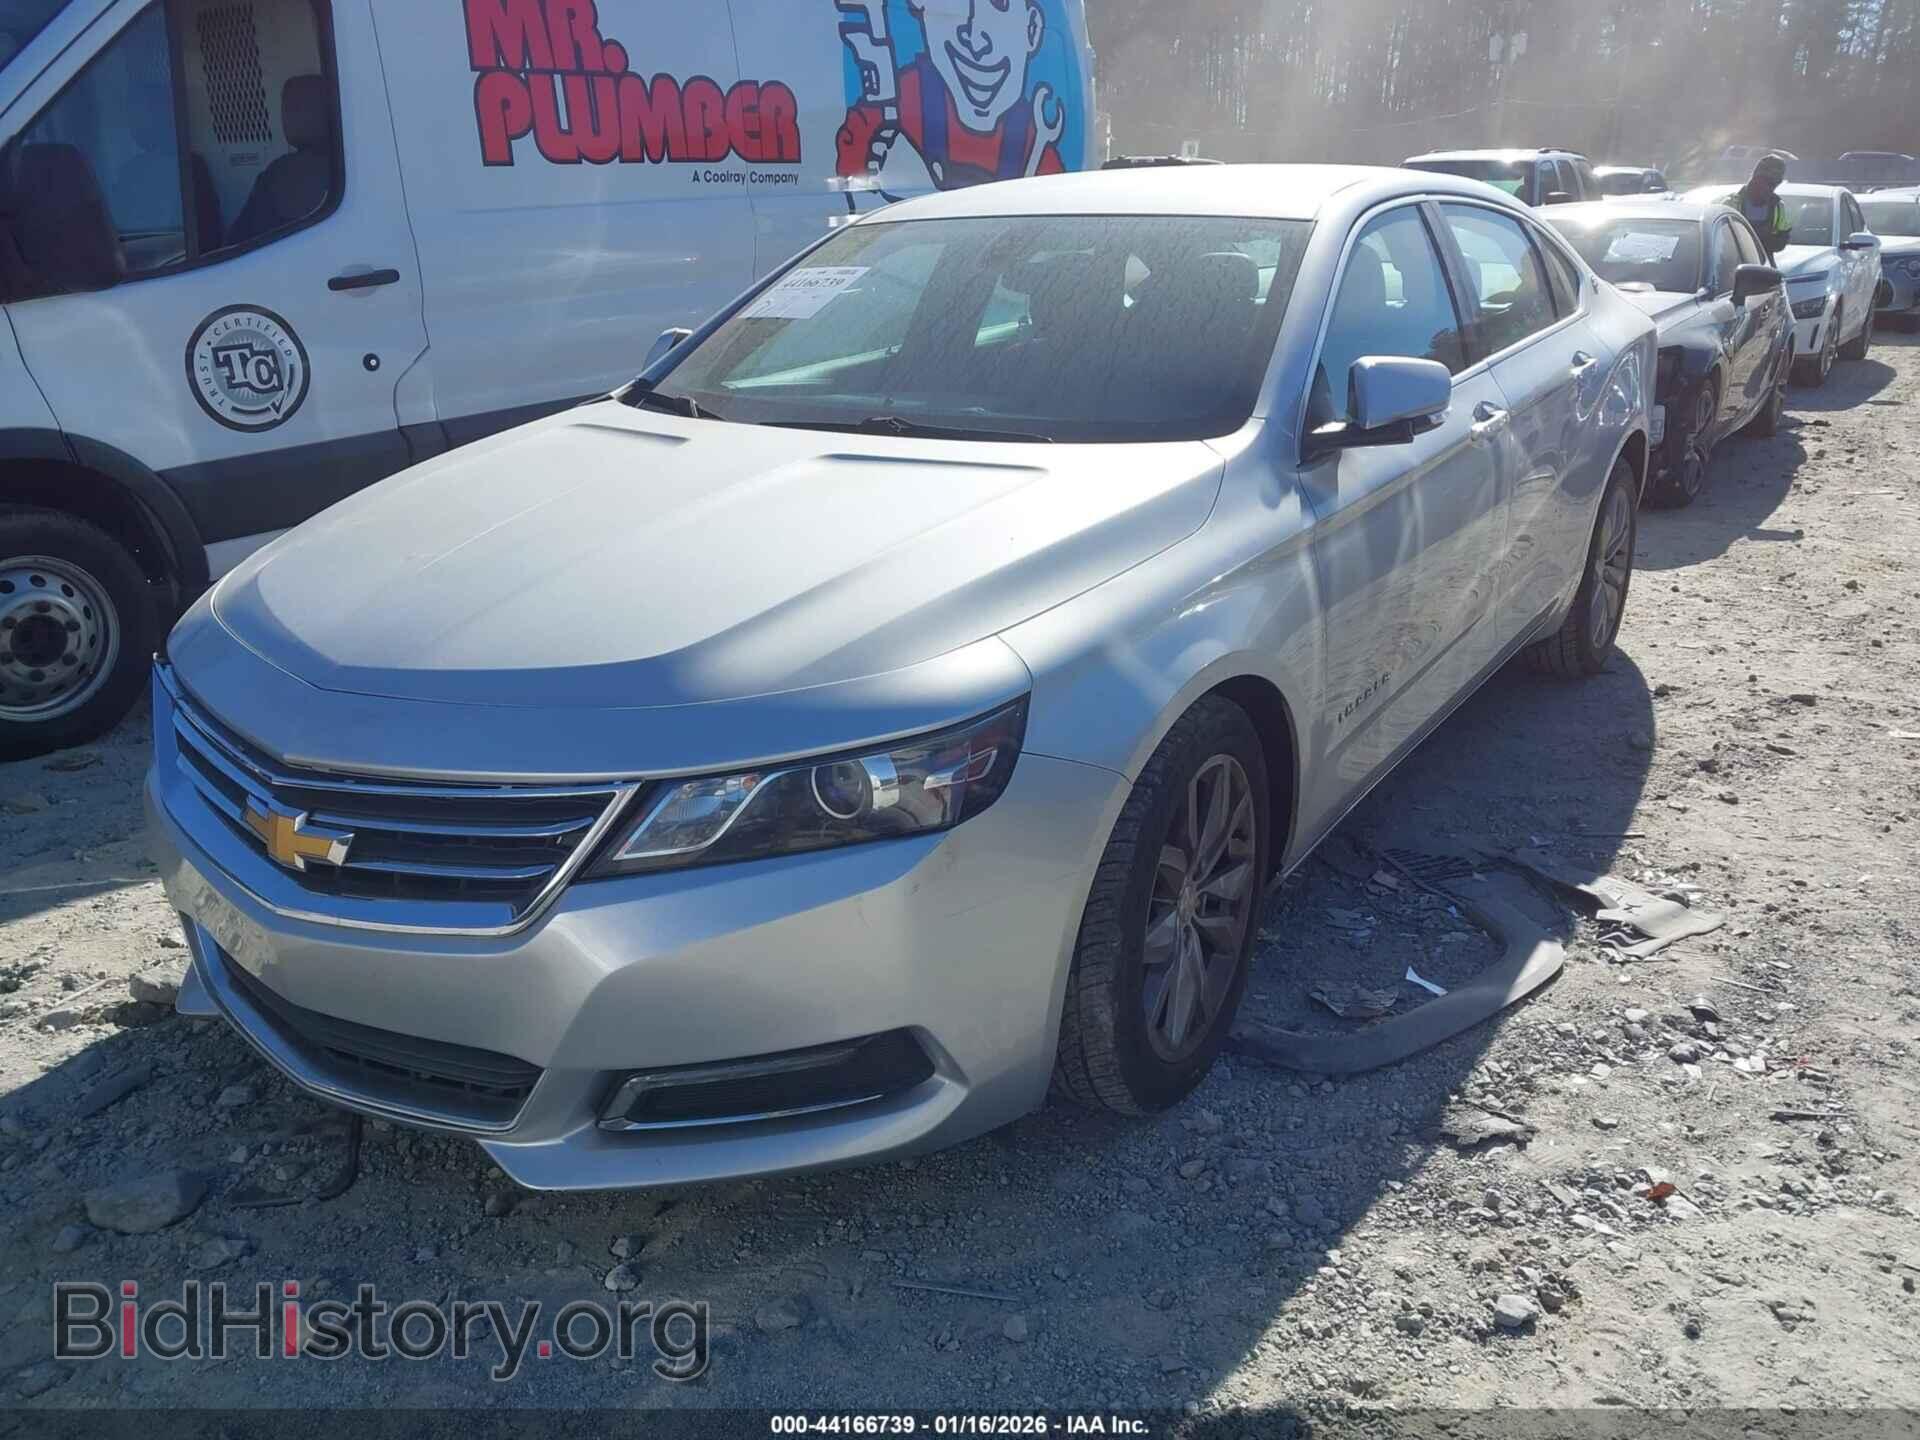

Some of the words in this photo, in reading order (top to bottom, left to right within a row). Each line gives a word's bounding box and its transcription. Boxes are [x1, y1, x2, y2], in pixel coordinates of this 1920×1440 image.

[462, 0, 629, 72] MR.
[474, 71, 802, 167] PLUMBER
[692, 170, 701, 183] A
[703, 170, 746, 185] Coolray
[750, 171, 799, 185] Company
[199, 354, 225, 407] TRUST
[213, 317, 293, 358] CERTIFIED
[214, 346, 281, 391] TC
